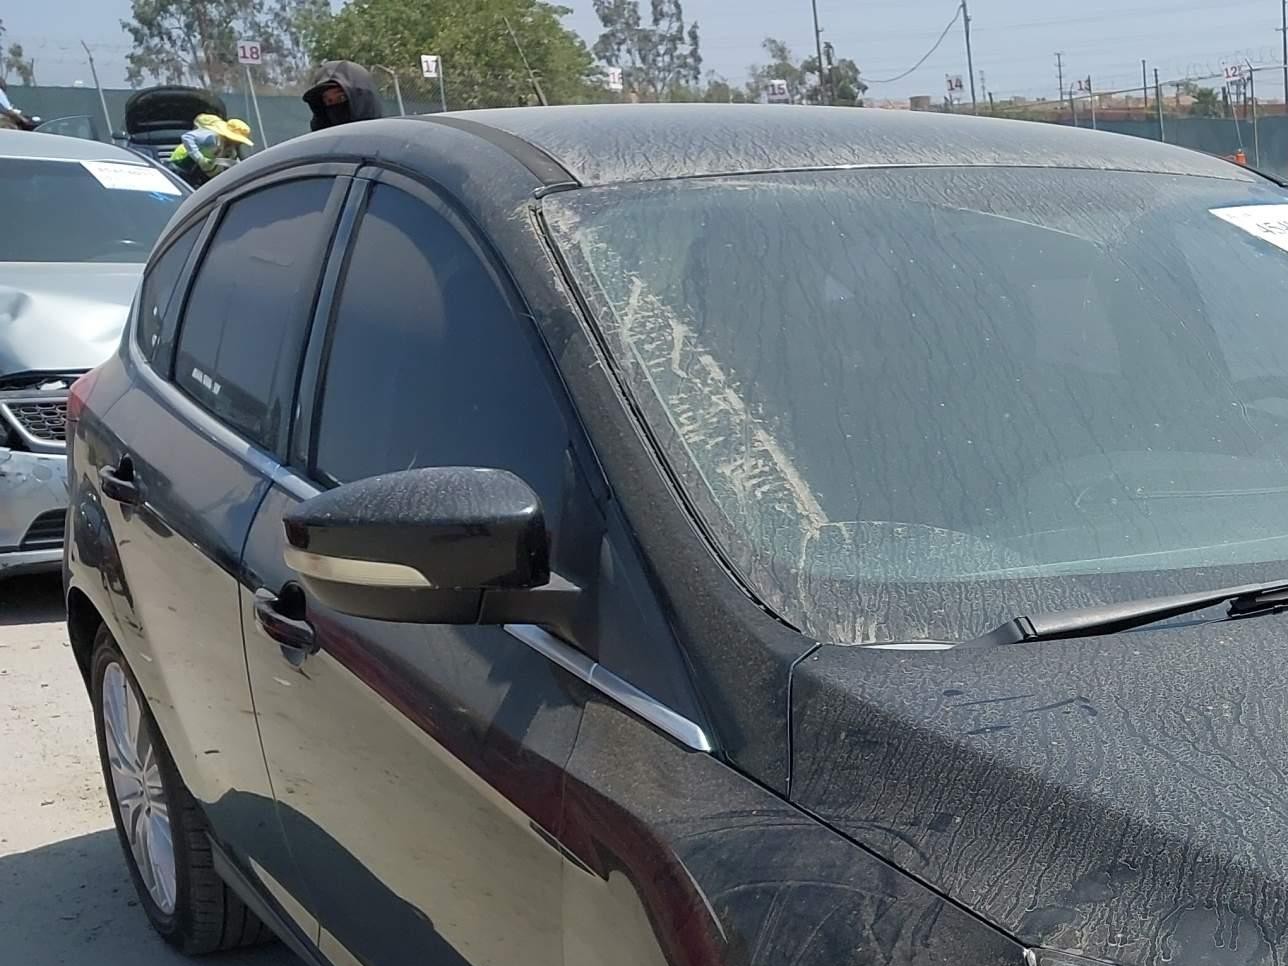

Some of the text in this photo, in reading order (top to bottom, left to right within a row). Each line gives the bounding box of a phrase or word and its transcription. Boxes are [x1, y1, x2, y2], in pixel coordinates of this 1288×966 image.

[239, 45, 261, 60] 18
[423, 58, 439, 74] 17
[1224, 65, 1238, 79] 12
[769, 83, 786, 96] 15
[947, 78, 964, 92] 14
